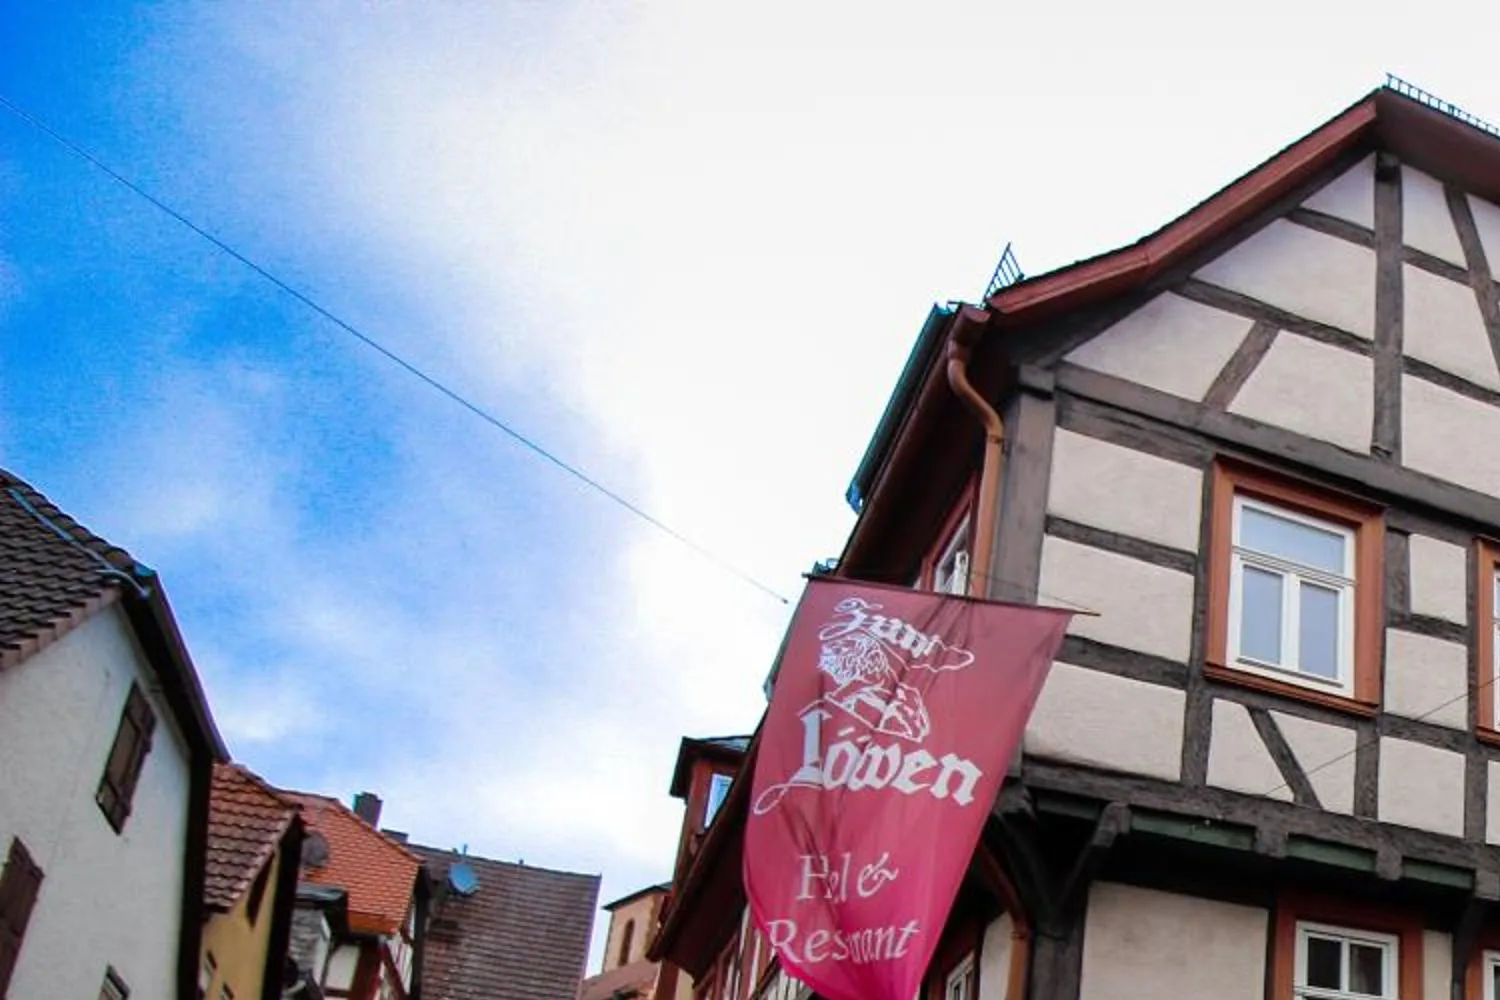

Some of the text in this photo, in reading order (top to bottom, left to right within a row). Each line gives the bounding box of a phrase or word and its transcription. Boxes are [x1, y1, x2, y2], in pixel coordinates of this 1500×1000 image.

[819, 597, 940, 660] Zum
[754, 701, 983, 814] Löwen
[857, 852, 899, 898] &
